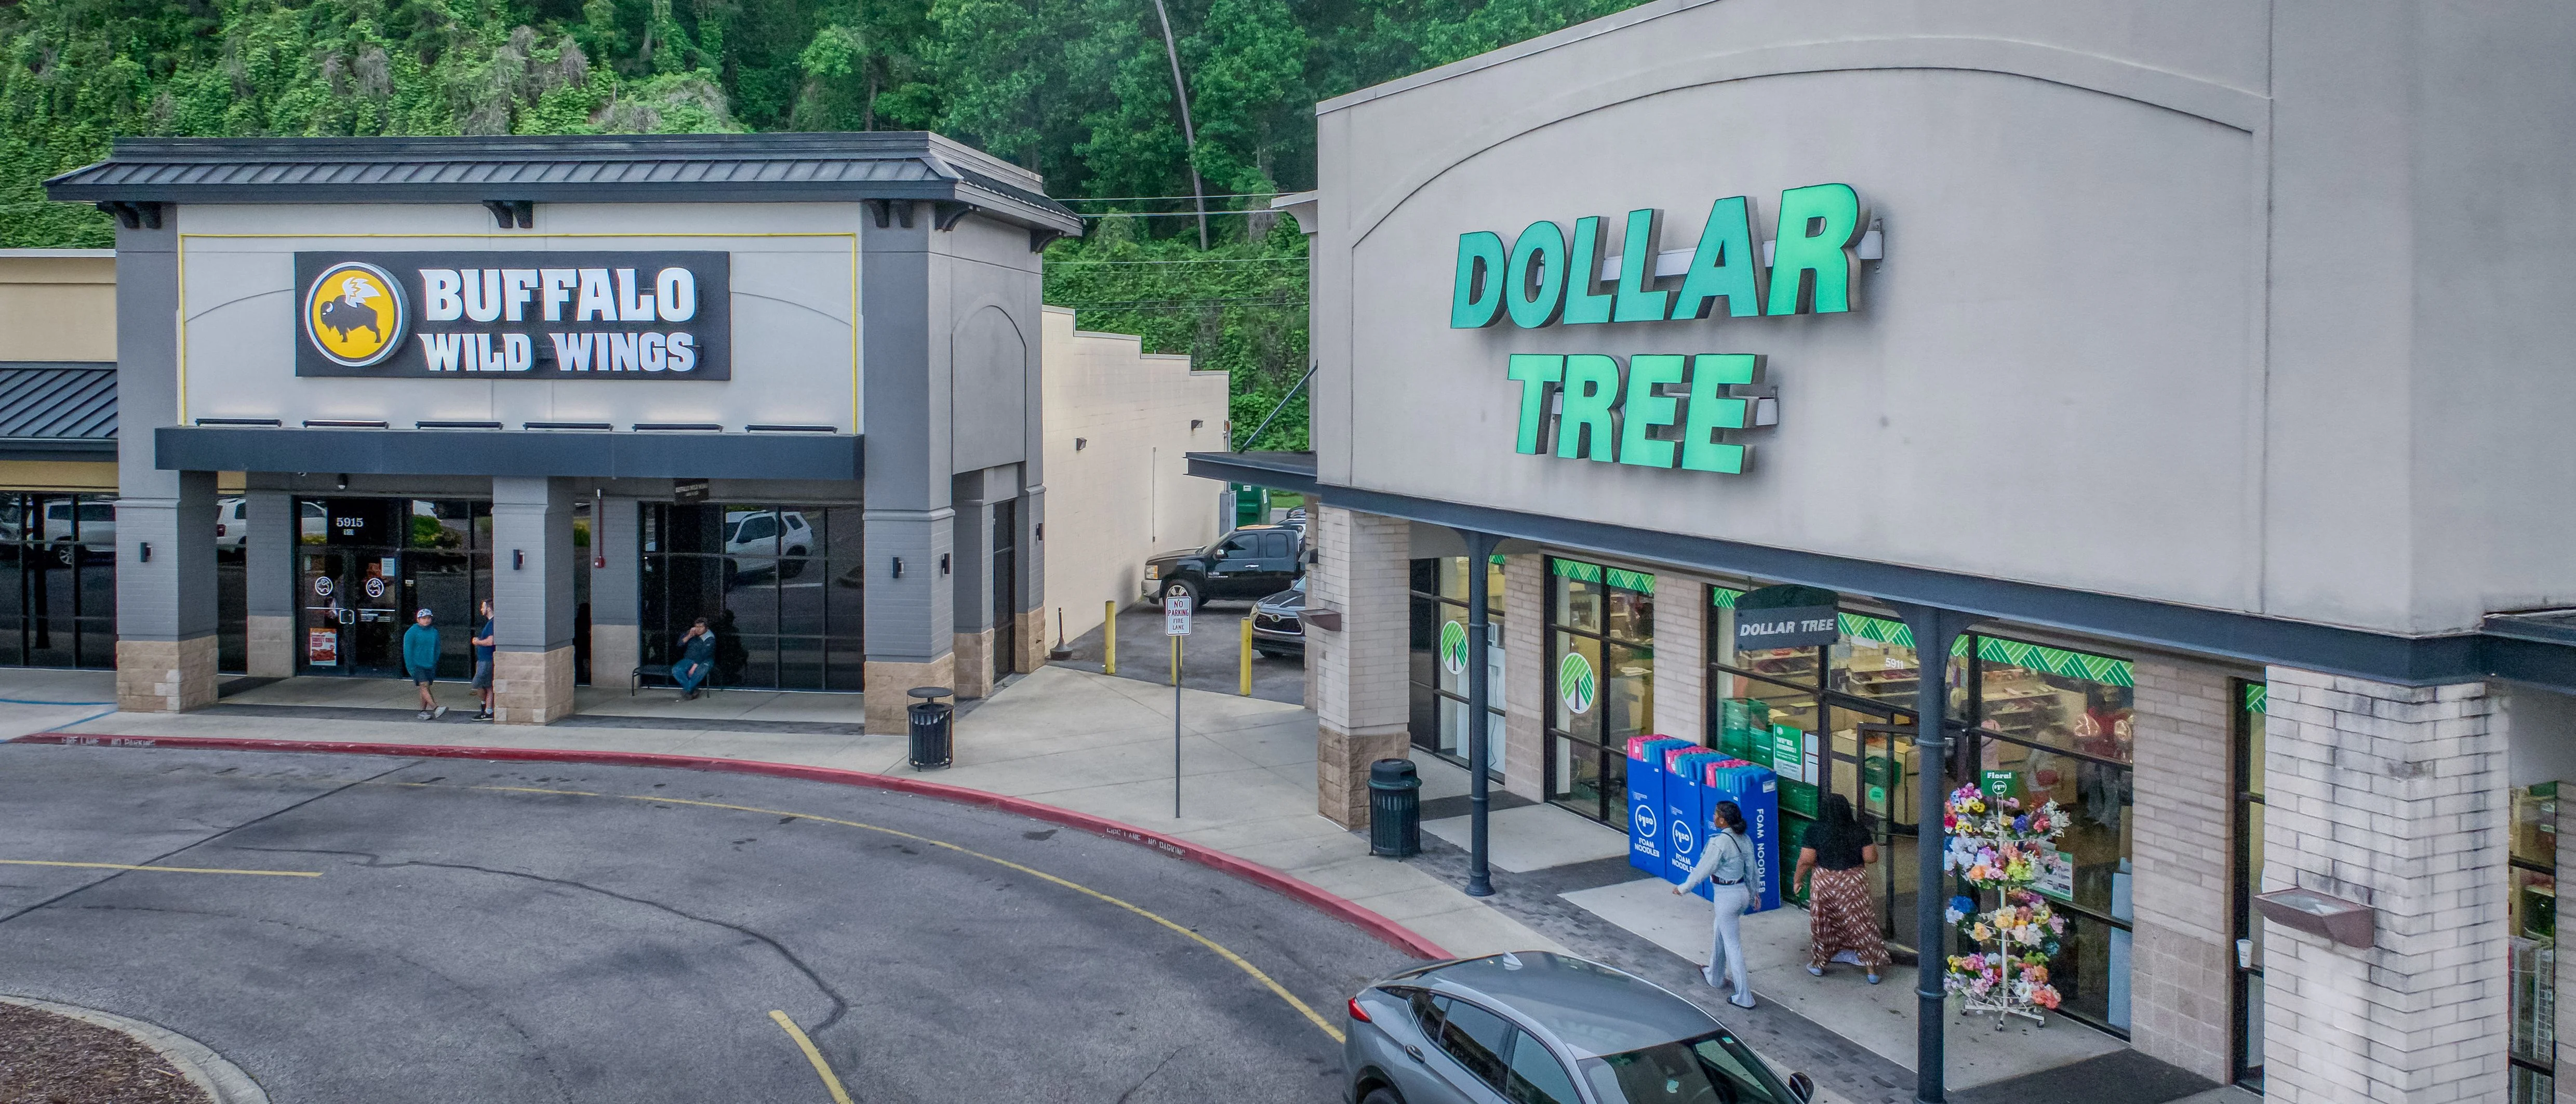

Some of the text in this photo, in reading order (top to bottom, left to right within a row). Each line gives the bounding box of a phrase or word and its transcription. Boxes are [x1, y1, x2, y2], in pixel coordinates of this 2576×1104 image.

[1450, 182, 1865, 329] DOLLAR
[419, 267, 696, 323] BUFFALO
[419, 331, 697, 372] WILD WINGS
[1507, 353, 1761, 475] TREE
[336, 517, 364, 527] 5915
[1740, 618, 1835, 636] DOLLAR TREE
[1886, 657, 1904, 670] 5911
[1638, 837, 1654, 848] FOAM
[1634, 843, 1660, 858] NOODLES
[1672, 858, 1693, 873] NOODLE
[1675, 852, 1691, 865] FOAM
